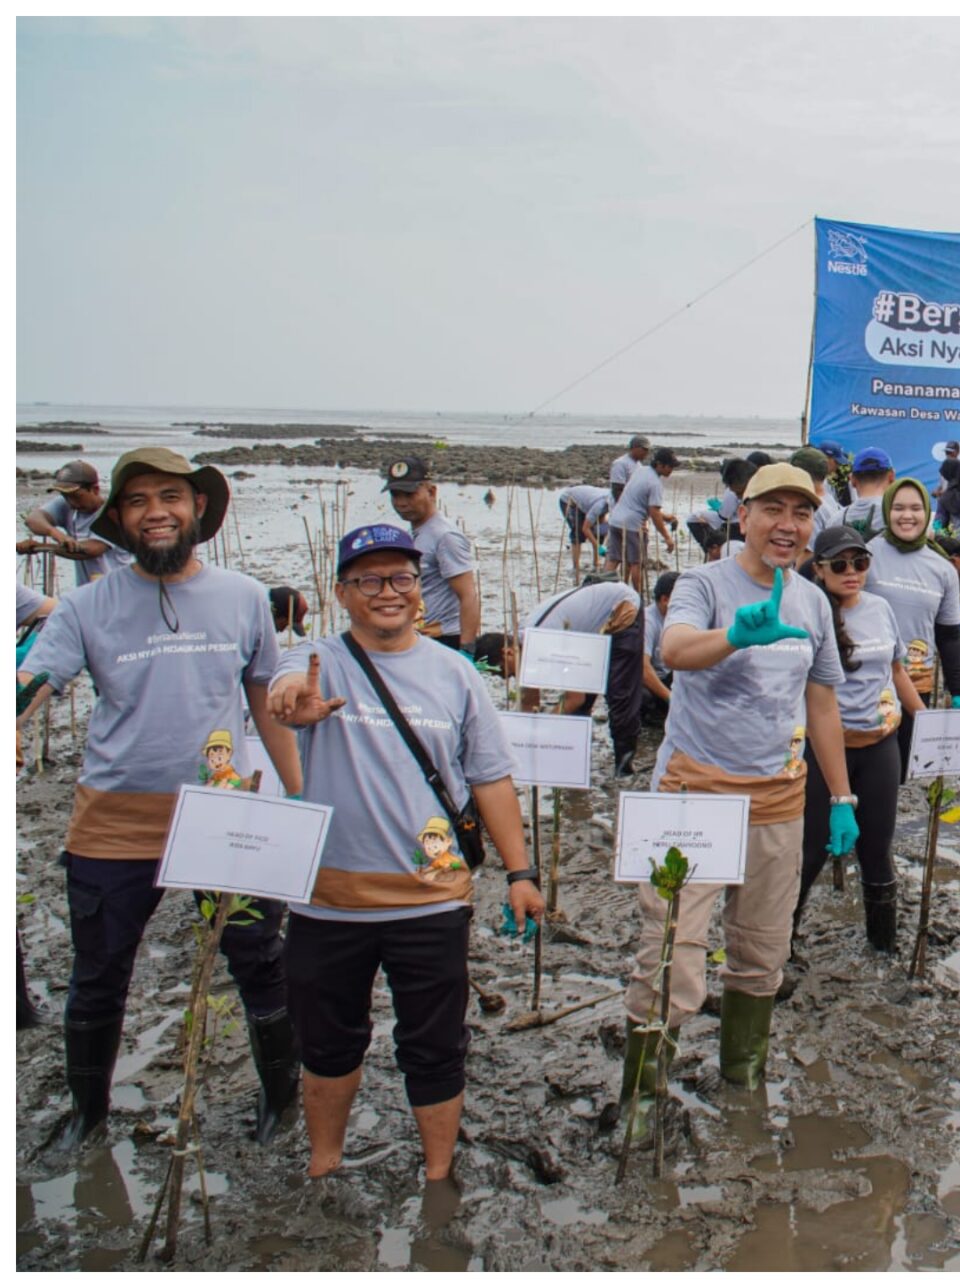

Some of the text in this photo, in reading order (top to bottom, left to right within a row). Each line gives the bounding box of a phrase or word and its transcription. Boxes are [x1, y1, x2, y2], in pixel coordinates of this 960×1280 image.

[880, 337, 923, 357] Aksi
[851, 404, 906, 418] Kawasan
[910, 408, 940, 420] Desa
